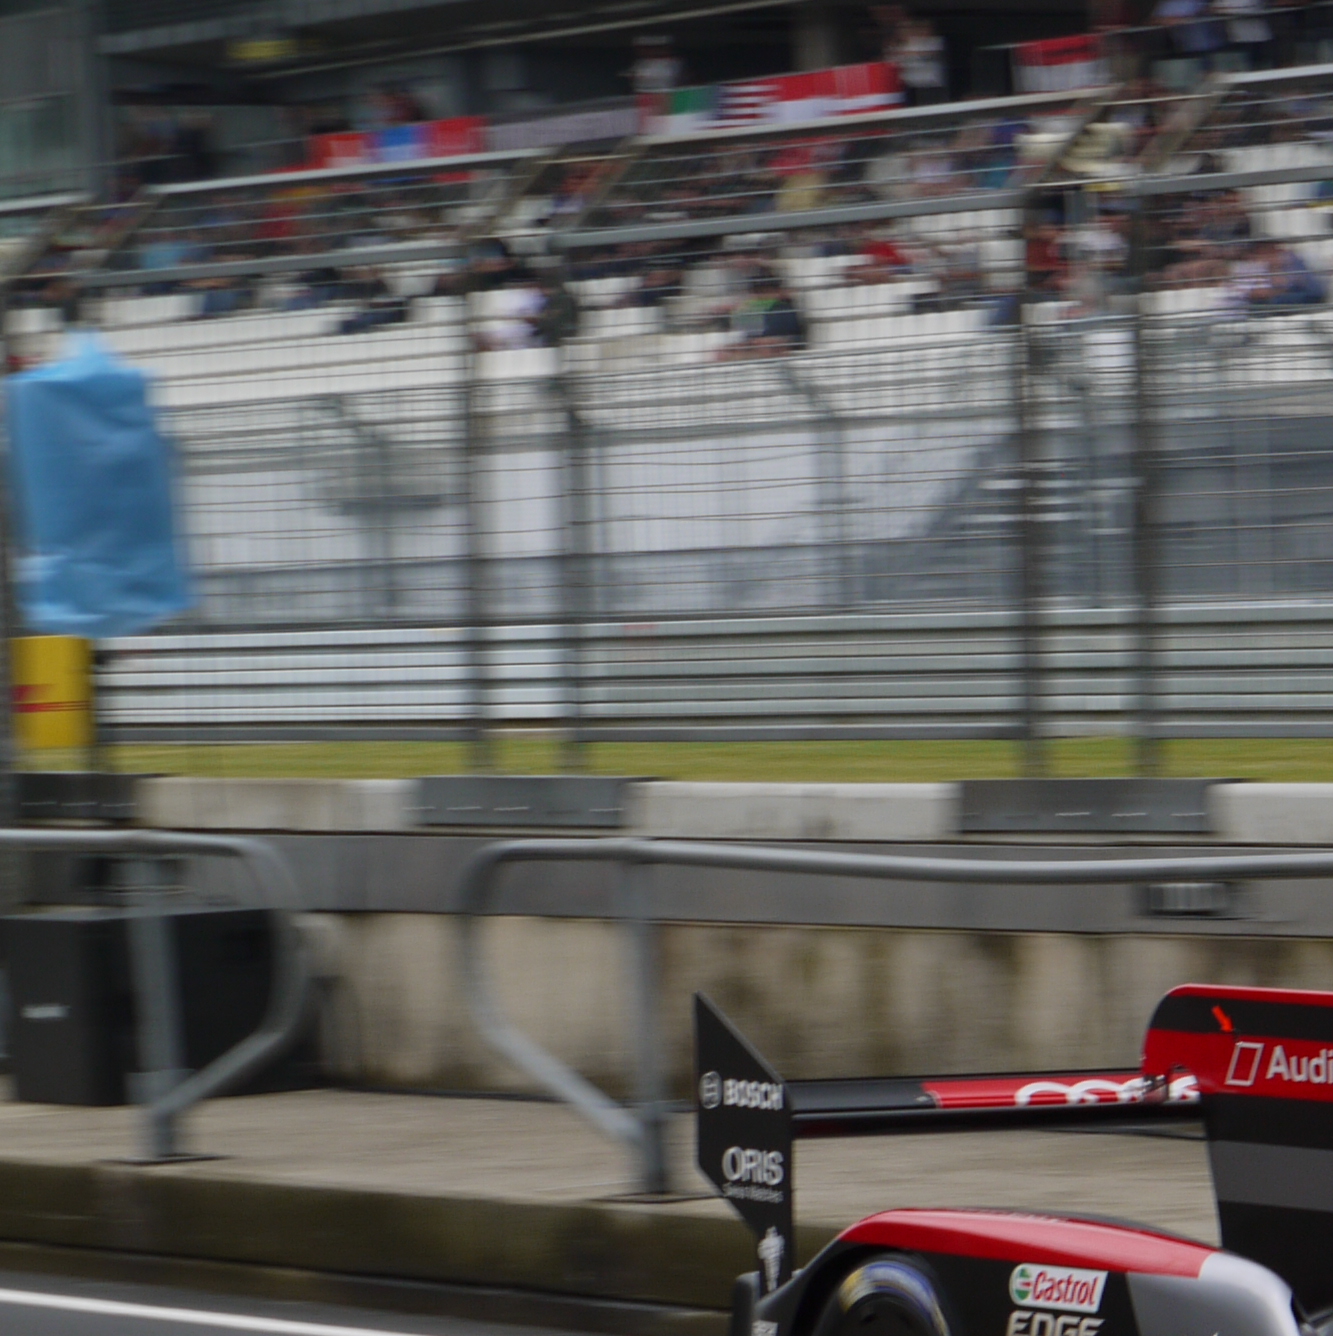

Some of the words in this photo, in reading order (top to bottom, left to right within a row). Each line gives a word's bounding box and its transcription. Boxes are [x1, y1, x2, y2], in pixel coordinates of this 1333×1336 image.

[723, 1078, 784, 1111] BOSCH
[722, 1145, 784, 1186] ORIS
[1033, 1270, 1099, 1306] Castrol
